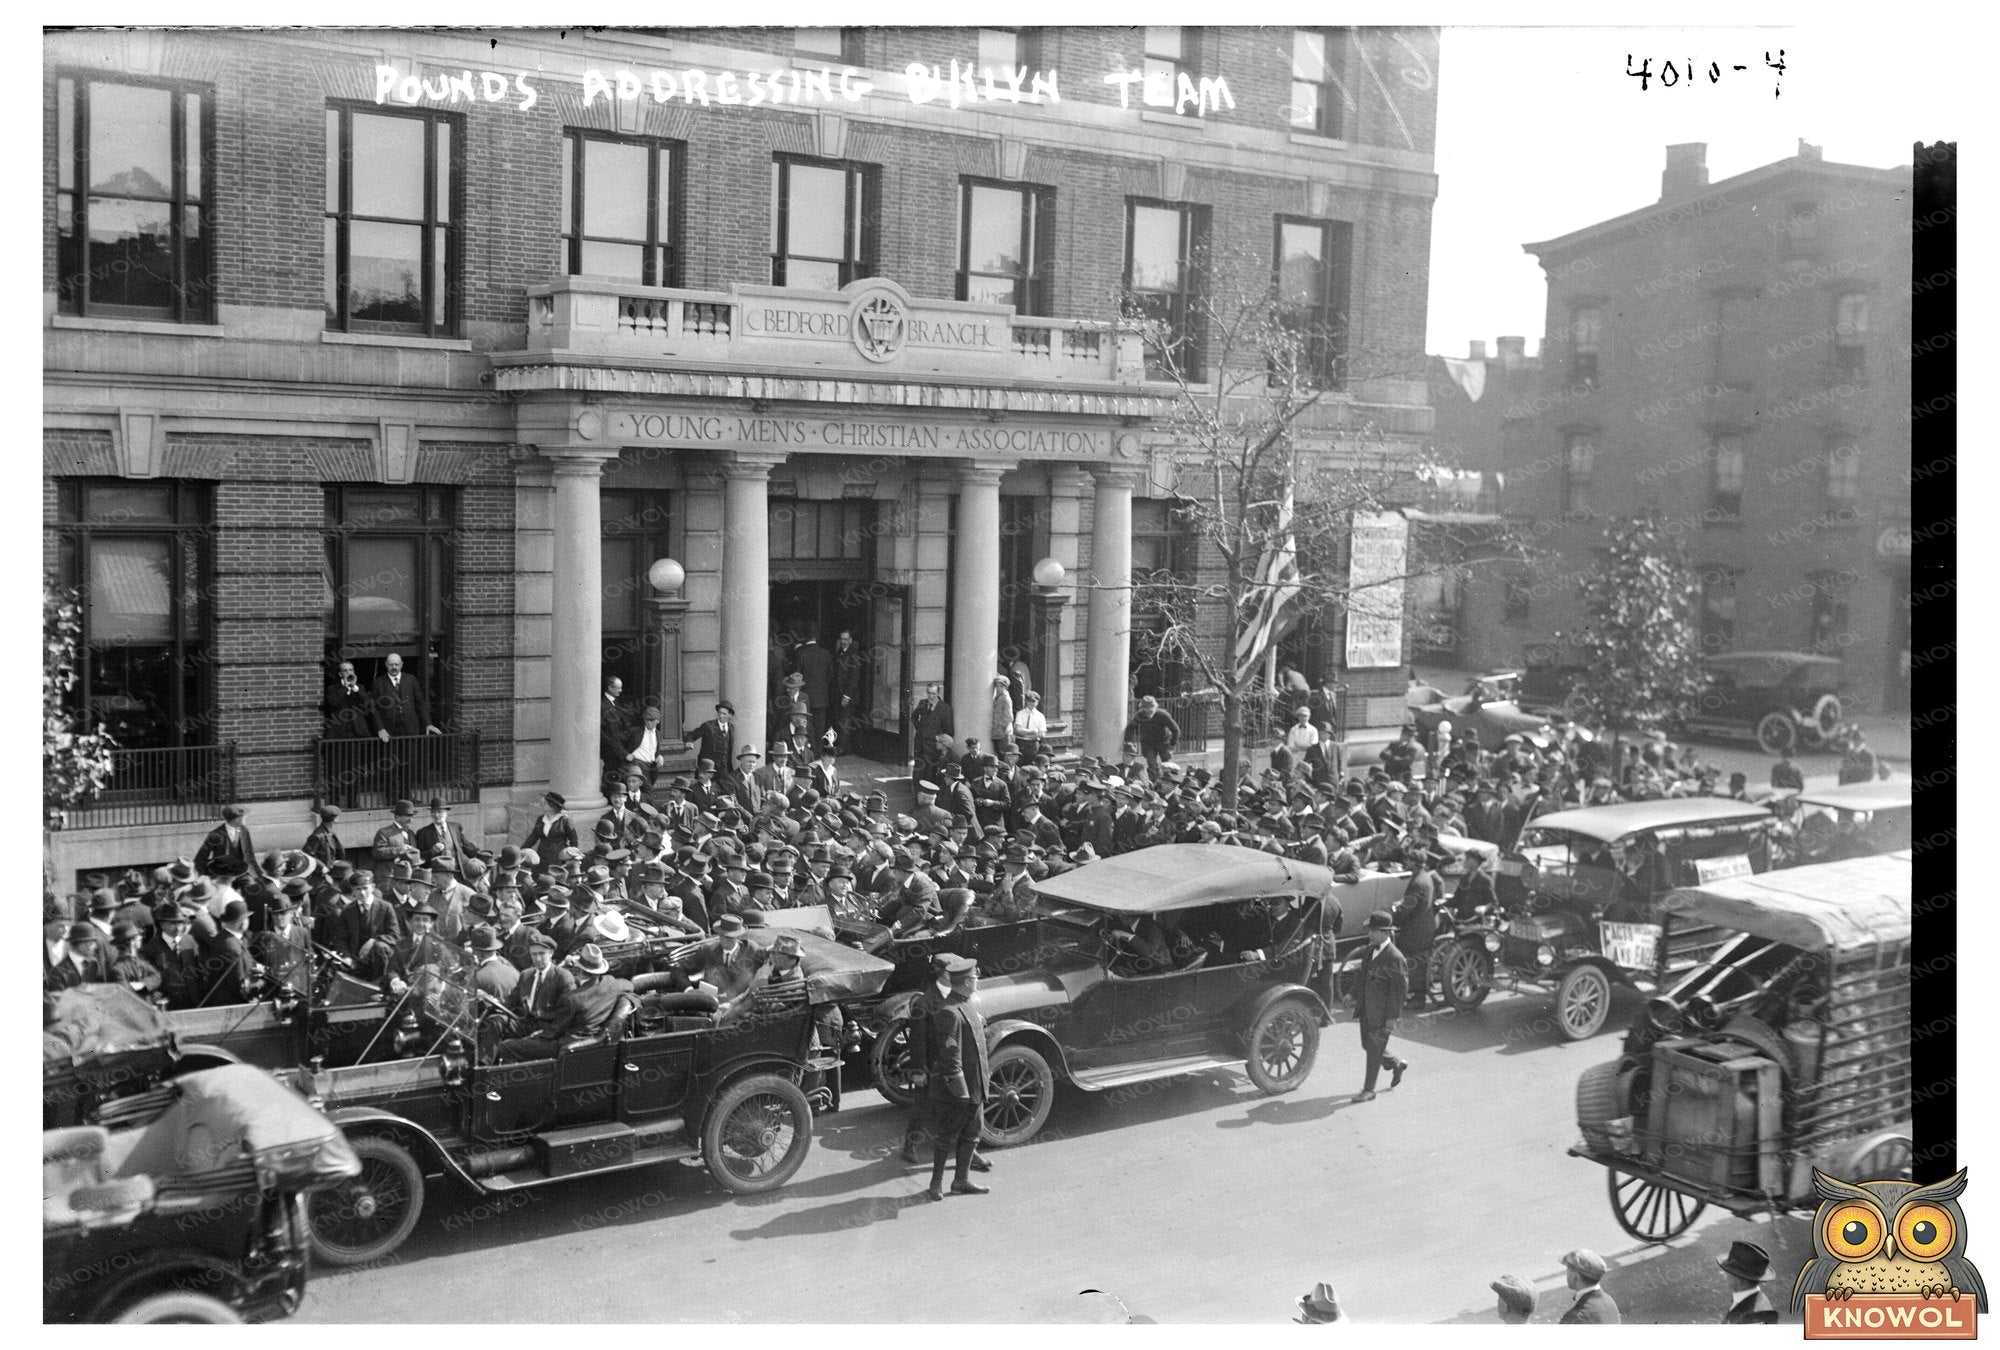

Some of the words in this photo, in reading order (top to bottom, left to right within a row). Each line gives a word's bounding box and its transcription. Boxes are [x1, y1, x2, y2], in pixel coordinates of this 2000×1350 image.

[763, 308, 850, 337] BEDFORD
[906, 319, 986, 346] BRANCH
[628, 414, 722, 441] YOUNG
[737, 418, 806, 444] MEN'S
[821, 422, 940, 449] CHRISTIAN
[955, 428, 1098, 454] ASSOCIATION
